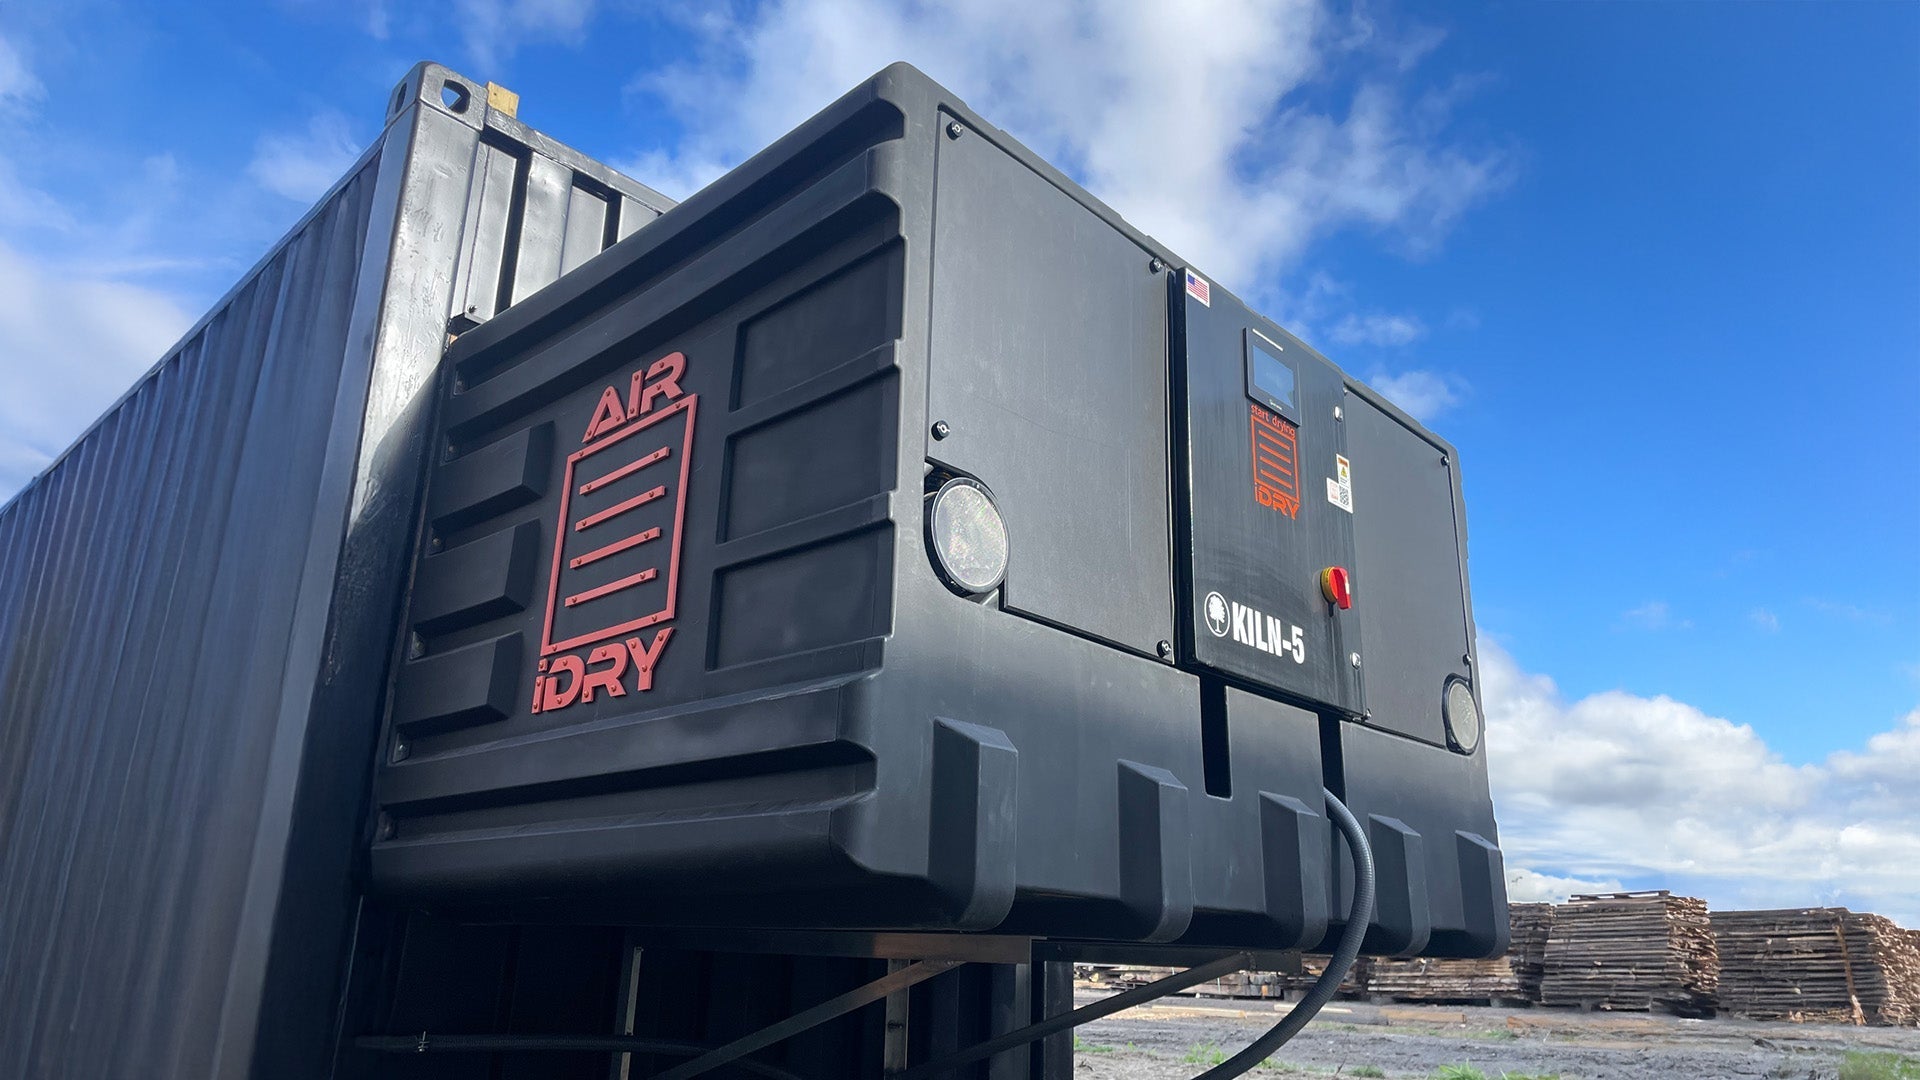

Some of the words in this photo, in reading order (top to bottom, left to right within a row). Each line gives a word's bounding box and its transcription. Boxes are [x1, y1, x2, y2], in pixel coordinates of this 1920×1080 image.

[582, 351, 687, 444] AIR
[1251, 404, 1269, 422] start
[1272, 415, 1296, 440] drying
[531, 626, 675, 714] iDRY
[1232, 601, 1305, 665] KILN-5
